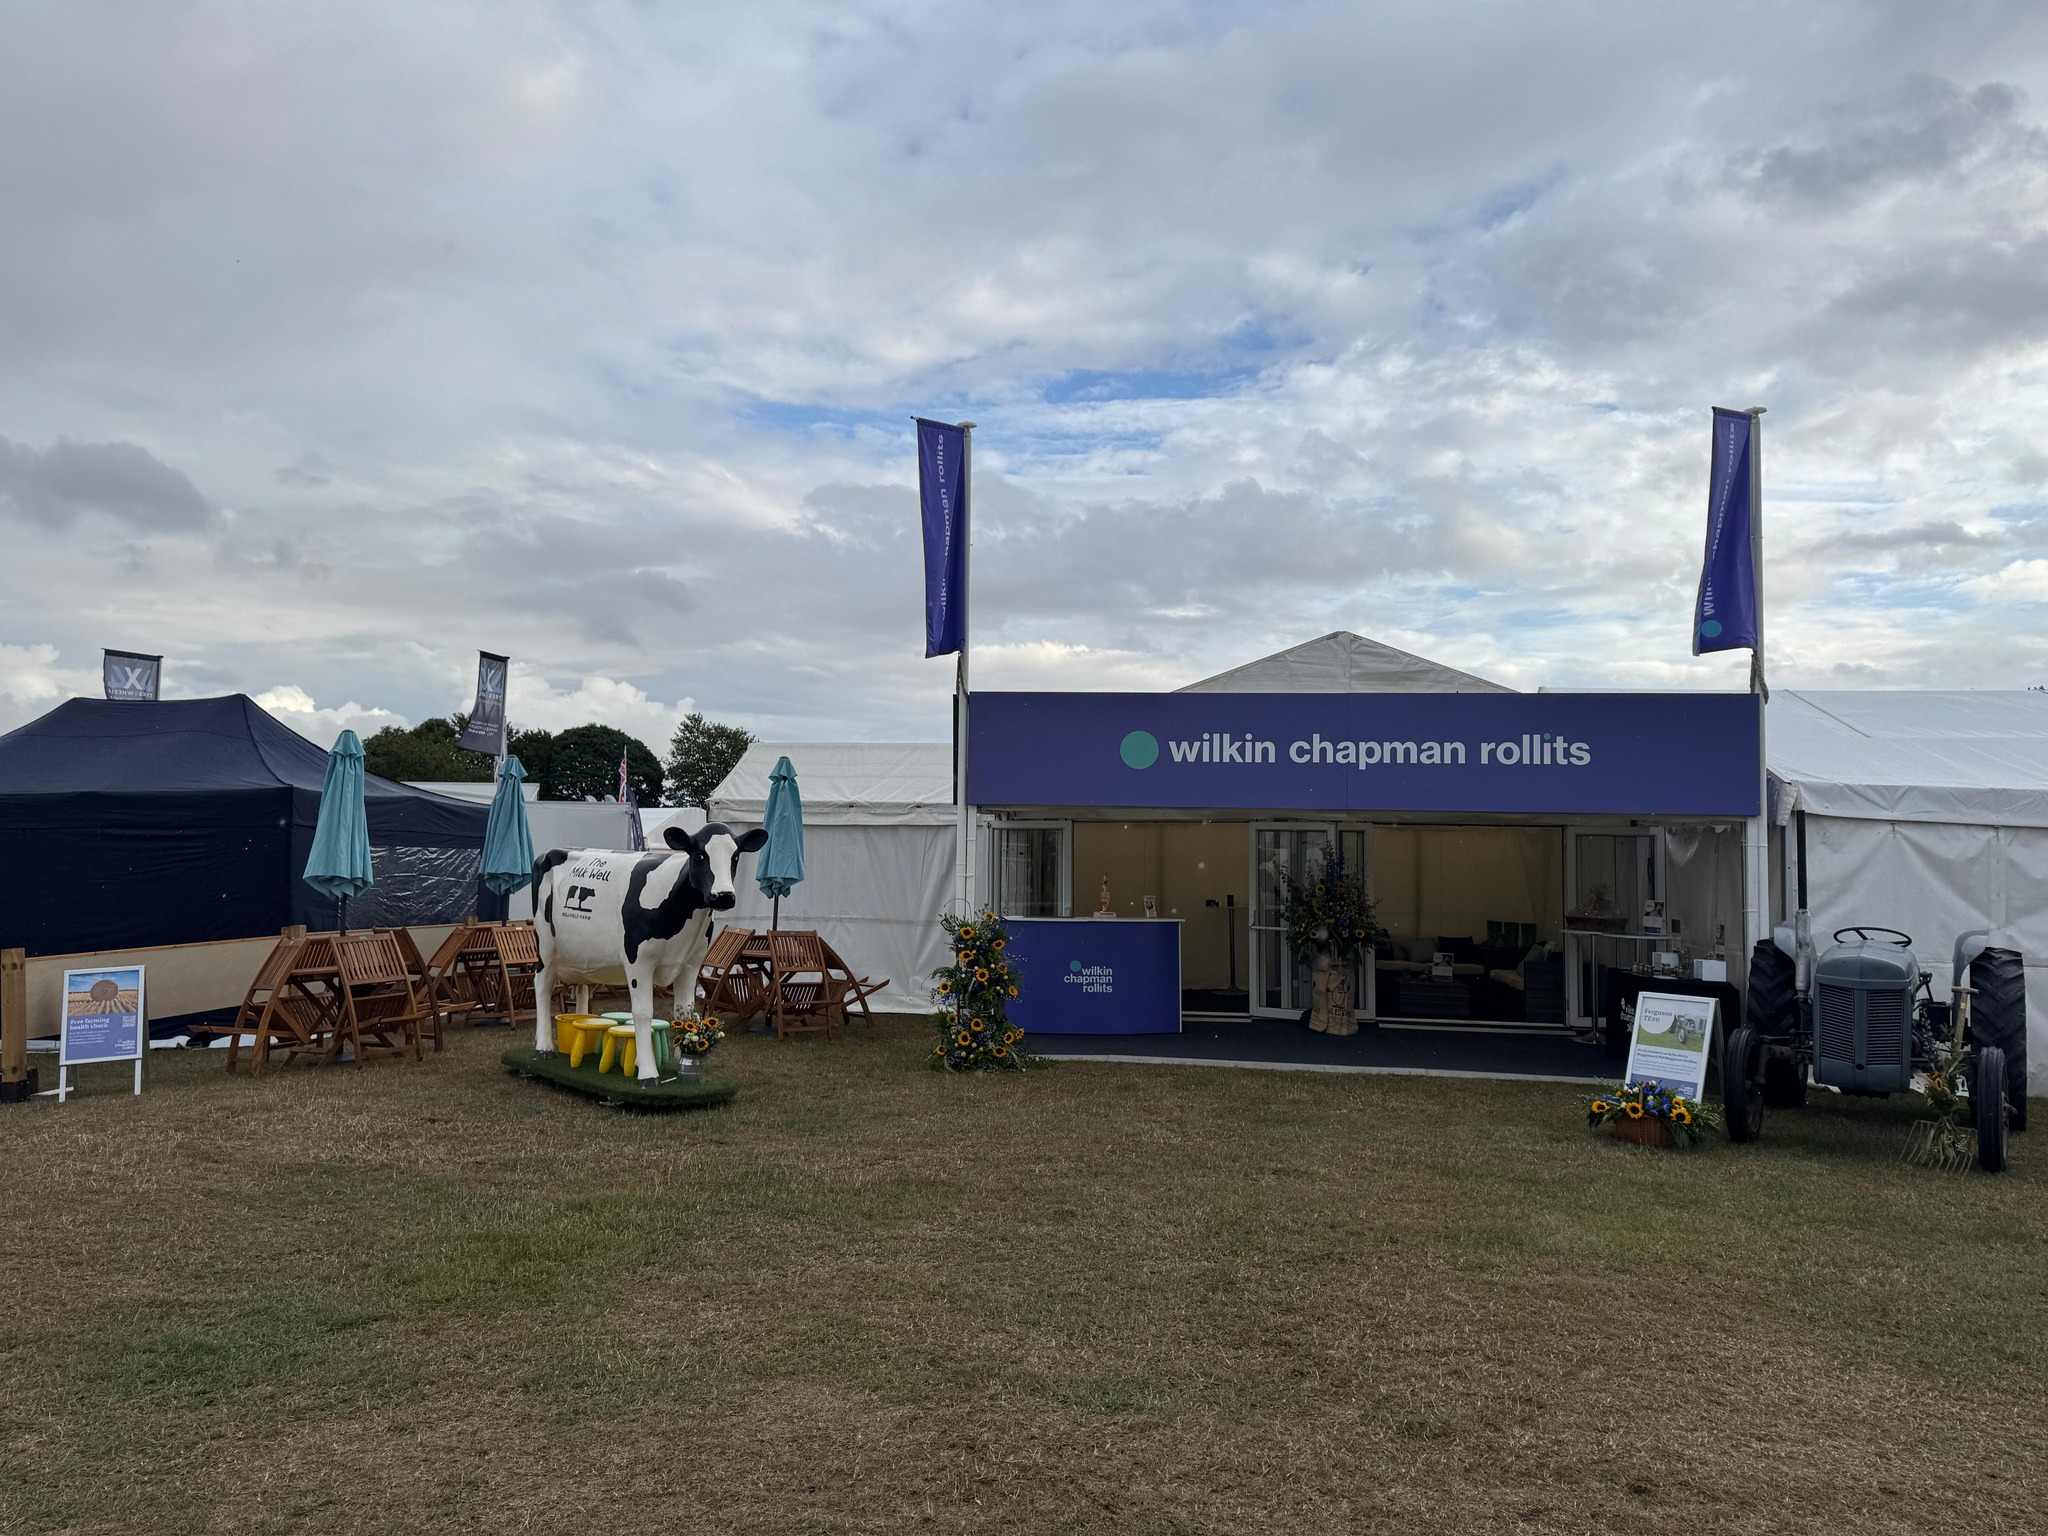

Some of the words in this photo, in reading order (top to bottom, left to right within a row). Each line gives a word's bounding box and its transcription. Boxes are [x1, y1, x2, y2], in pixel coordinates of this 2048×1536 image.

[937, 434, 945, 483] rollits
[1168, 733, 1276, 763] wilkin
[1289, 733, 1466, 770] chapman
[1480, 732, 1591, 765] rollits
[589, 858, 607, 867] The
[569, 867, 588, 878] Milk
[589, 869, 611, 882] Well
[1082, 966, 1112, 975] wilkin
[1064, 973, 1112, 985] chapman
[1083, 983, 1113, 993] rollits
[1644, 1008, 1673, 1017] Ferguson
[69, 1023, 89, 1031] health
